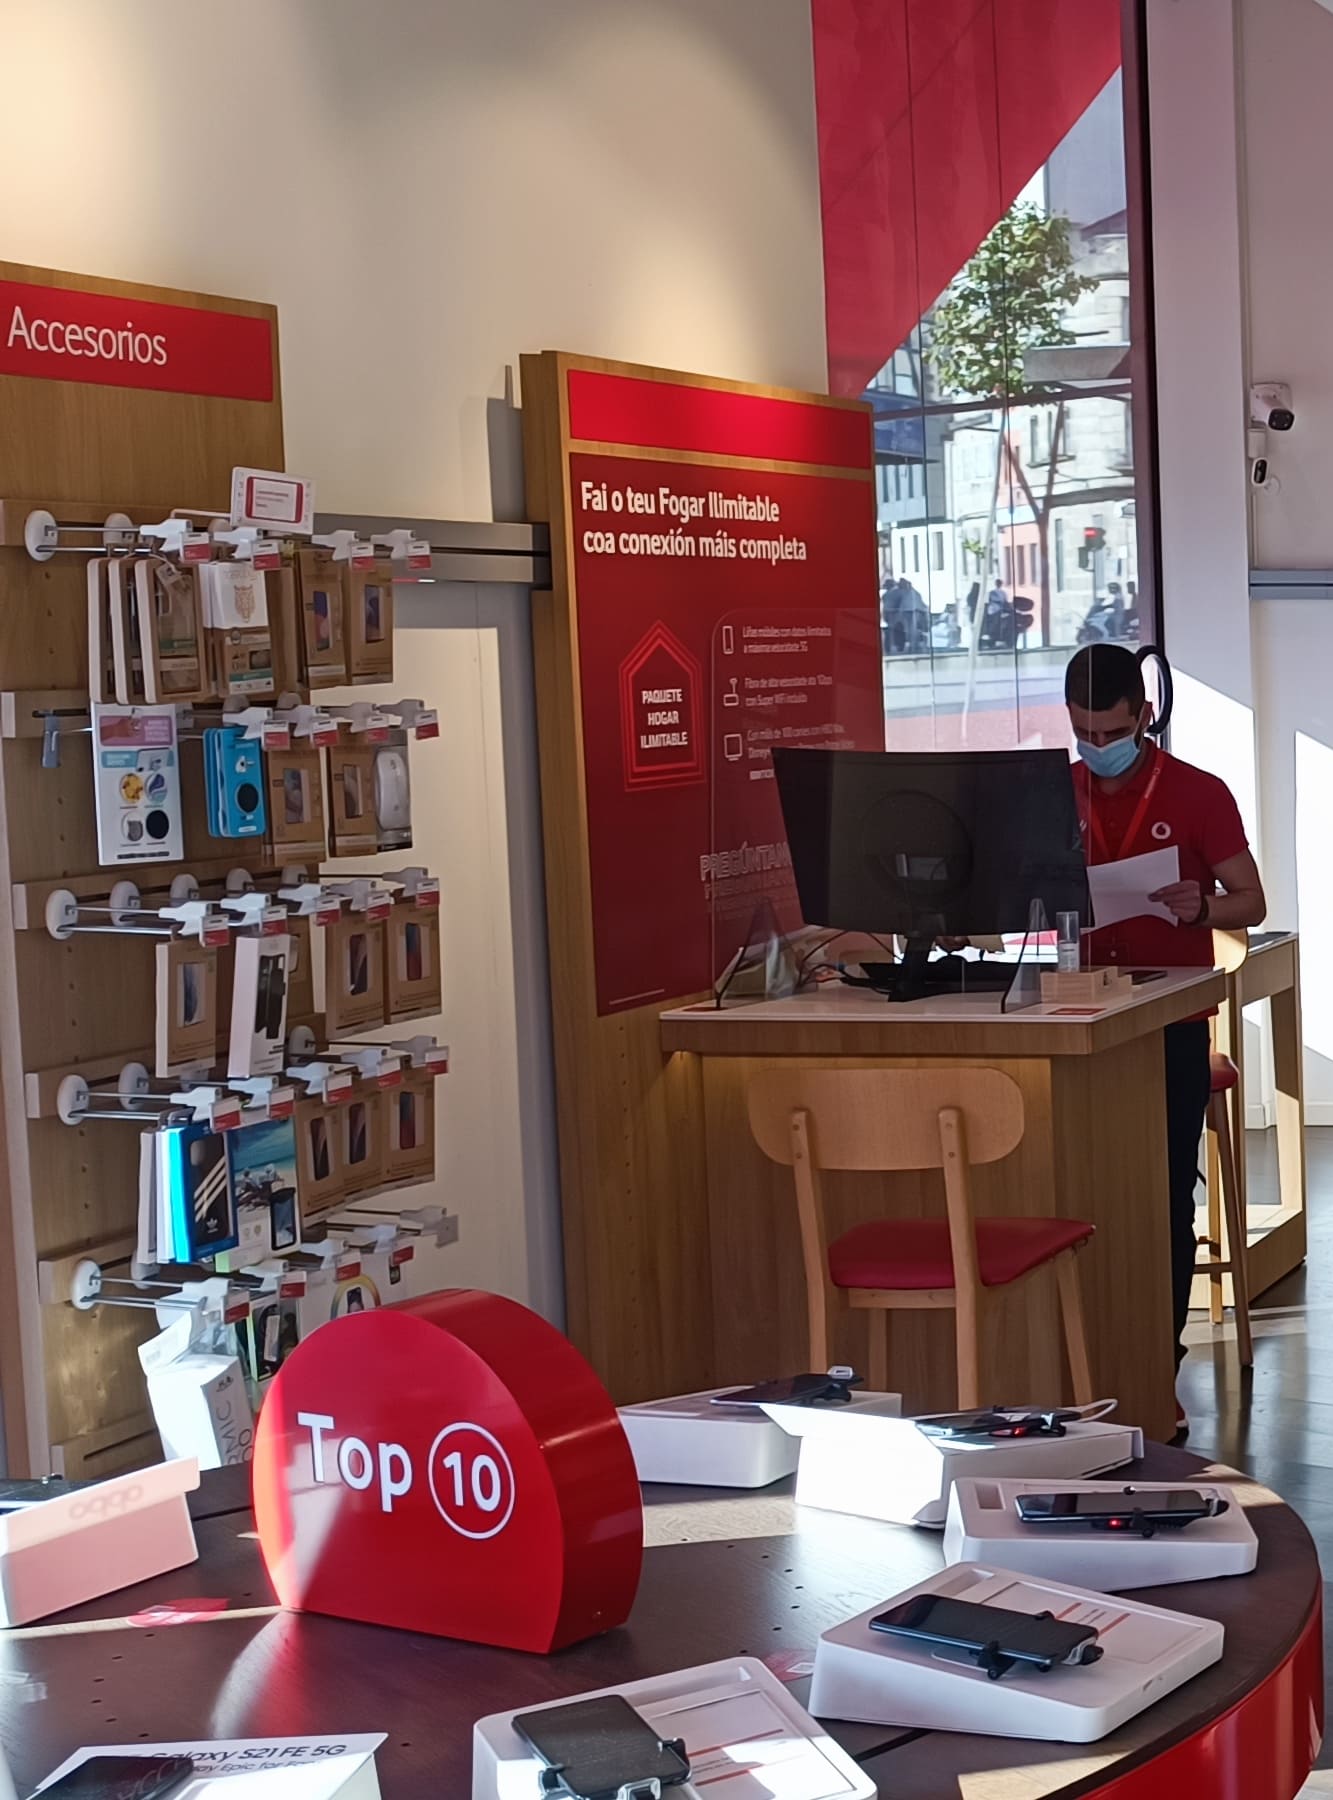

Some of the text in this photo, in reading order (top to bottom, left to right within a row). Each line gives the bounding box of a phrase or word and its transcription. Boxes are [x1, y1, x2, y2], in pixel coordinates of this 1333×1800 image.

[7, 305, 168, 366] Accesorios
[580, 481, 780, 524] Fai o teu Fogar Ilimitable
[583, 528, 807, 566] coa conexión máis completa
[641, 688, 683, 704] PAQUETE
[647, 710, 679, 726] HOGAR
[640, 731, 688, 749] ILIMITABLE
[297, 1411, 413, 1513] Top
[442, 1450, 501, 1512] 10
[238, 1747, 277, 1760] S21
[279, 1745, 308, 1757] FE
[310, 1744, 348, 1756] 5G
